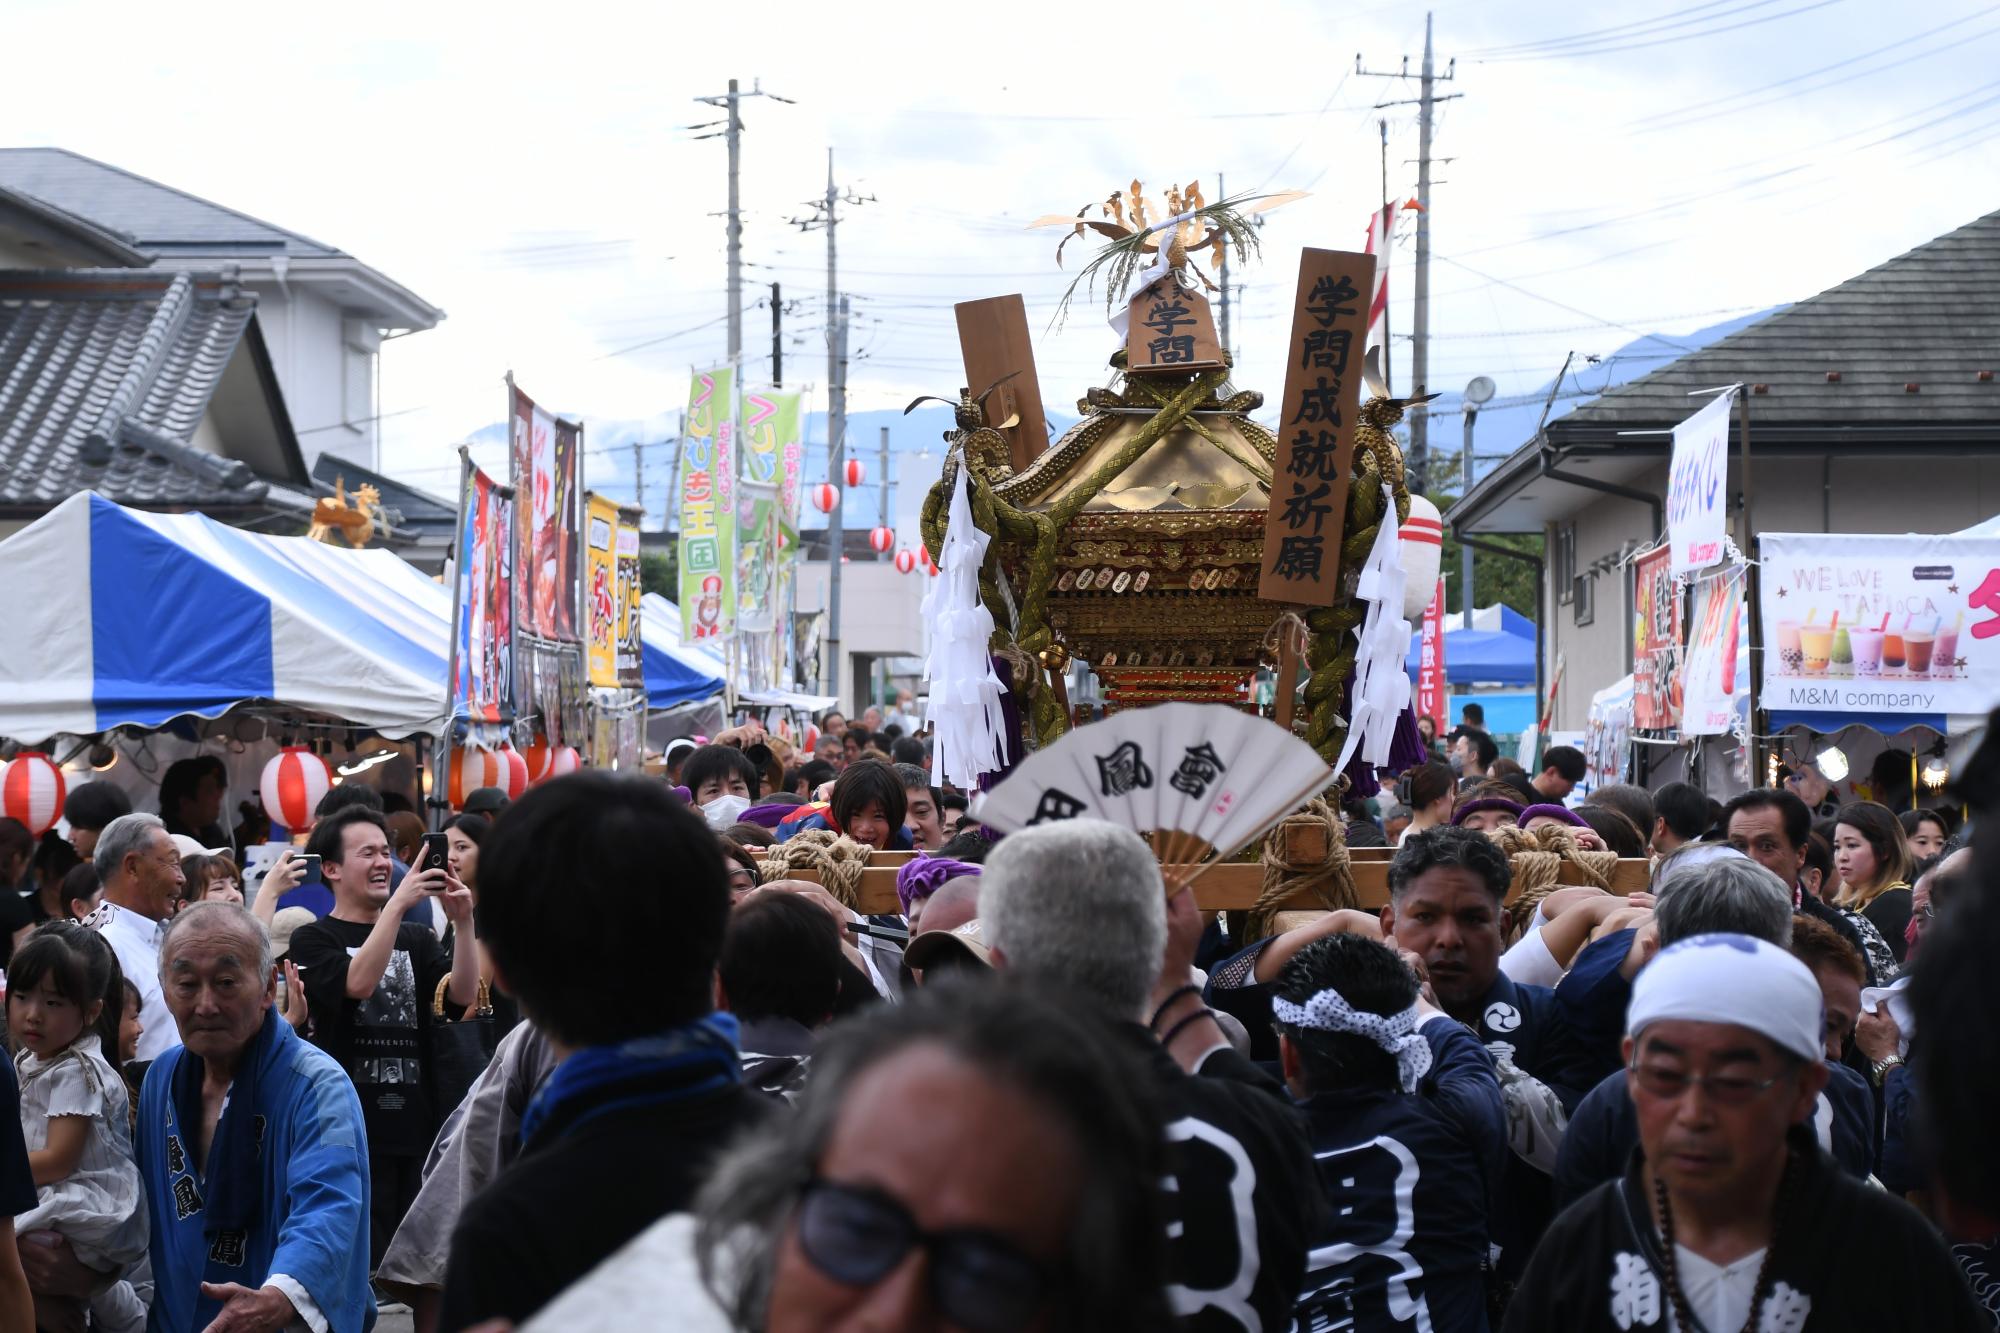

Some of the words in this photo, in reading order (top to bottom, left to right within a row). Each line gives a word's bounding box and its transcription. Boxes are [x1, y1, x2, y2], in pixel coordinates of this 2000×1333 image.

[1271, 275, 1360, 583] 学問成就祈願
[1793, 566, 1832, 592] WE
[1790, 687, 1839, 705] M&M
[1845, 693, 1935, 709] company
